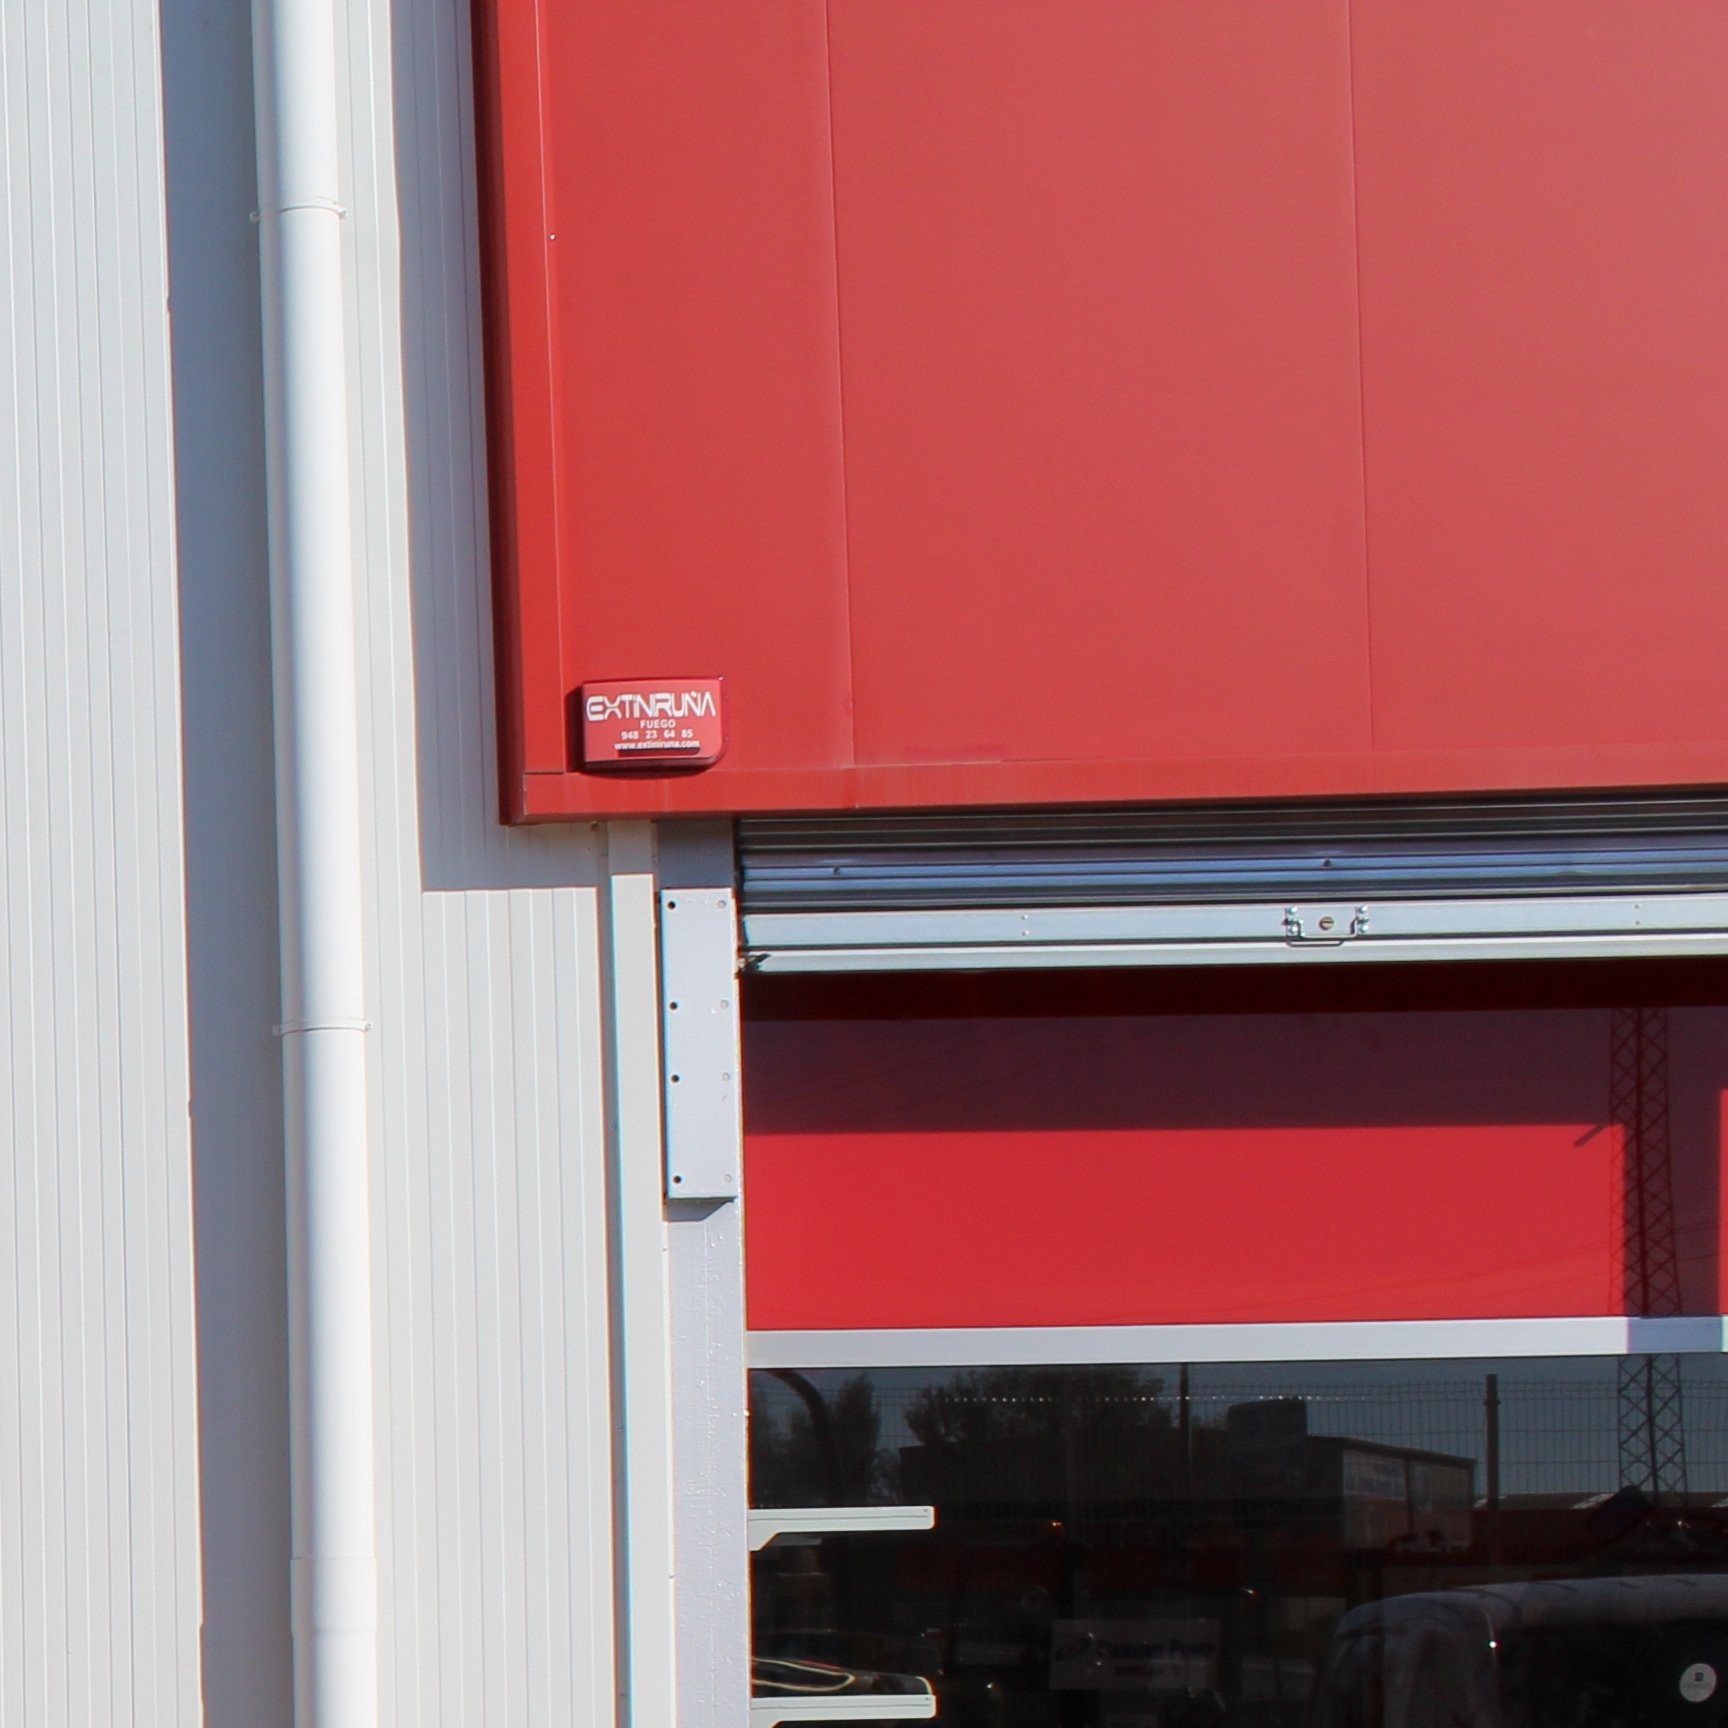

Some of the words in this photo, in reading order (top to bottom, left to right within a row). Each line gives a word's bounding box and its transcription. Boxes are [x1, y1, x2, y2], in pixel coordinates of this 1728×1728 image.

[586, 690, 716, 721] EXTINIRUÑA
[639, 719, 676, 728] FUEGO
[621, 731, 640, 740] 948
